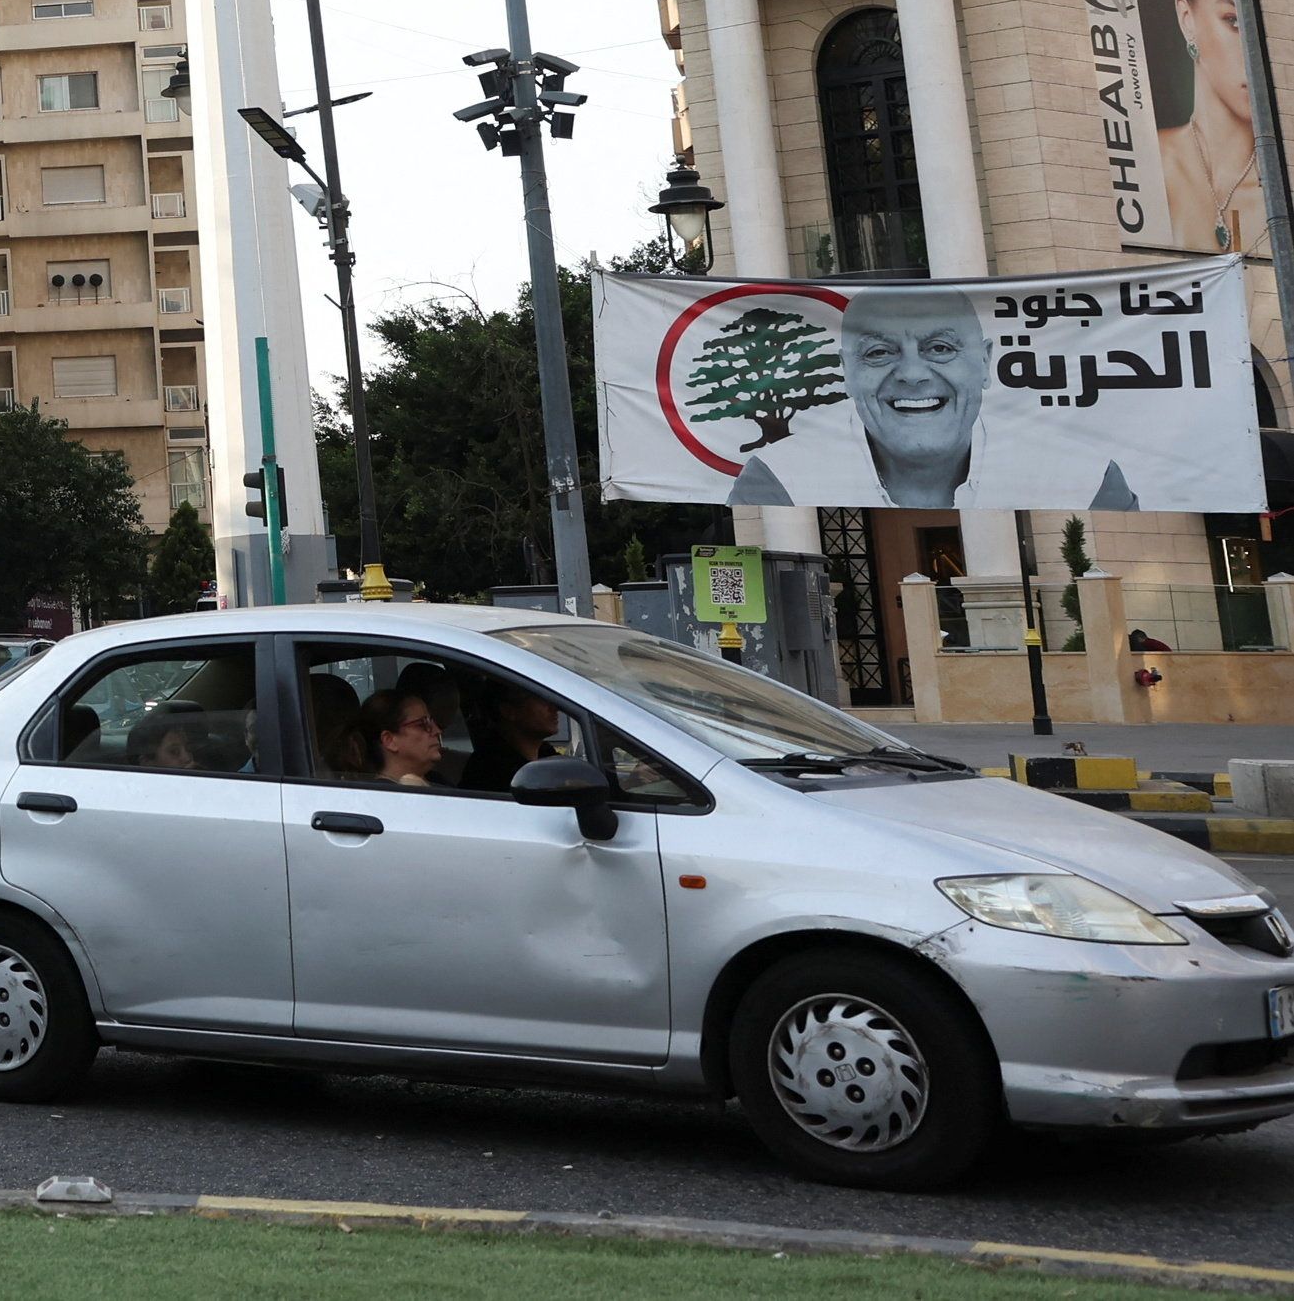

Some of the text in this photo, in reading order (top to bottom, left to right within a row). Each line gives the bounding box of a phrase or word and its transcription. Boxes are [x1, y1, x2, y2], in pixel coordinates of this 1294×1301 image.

[1127, 33, 1143, 110] Jewellery
[1090, 23, 1144, 234] CHEAIB
[994, 281, 1204, 329] نحنا جنود
[996, 330, 1212, 408] الحرية
